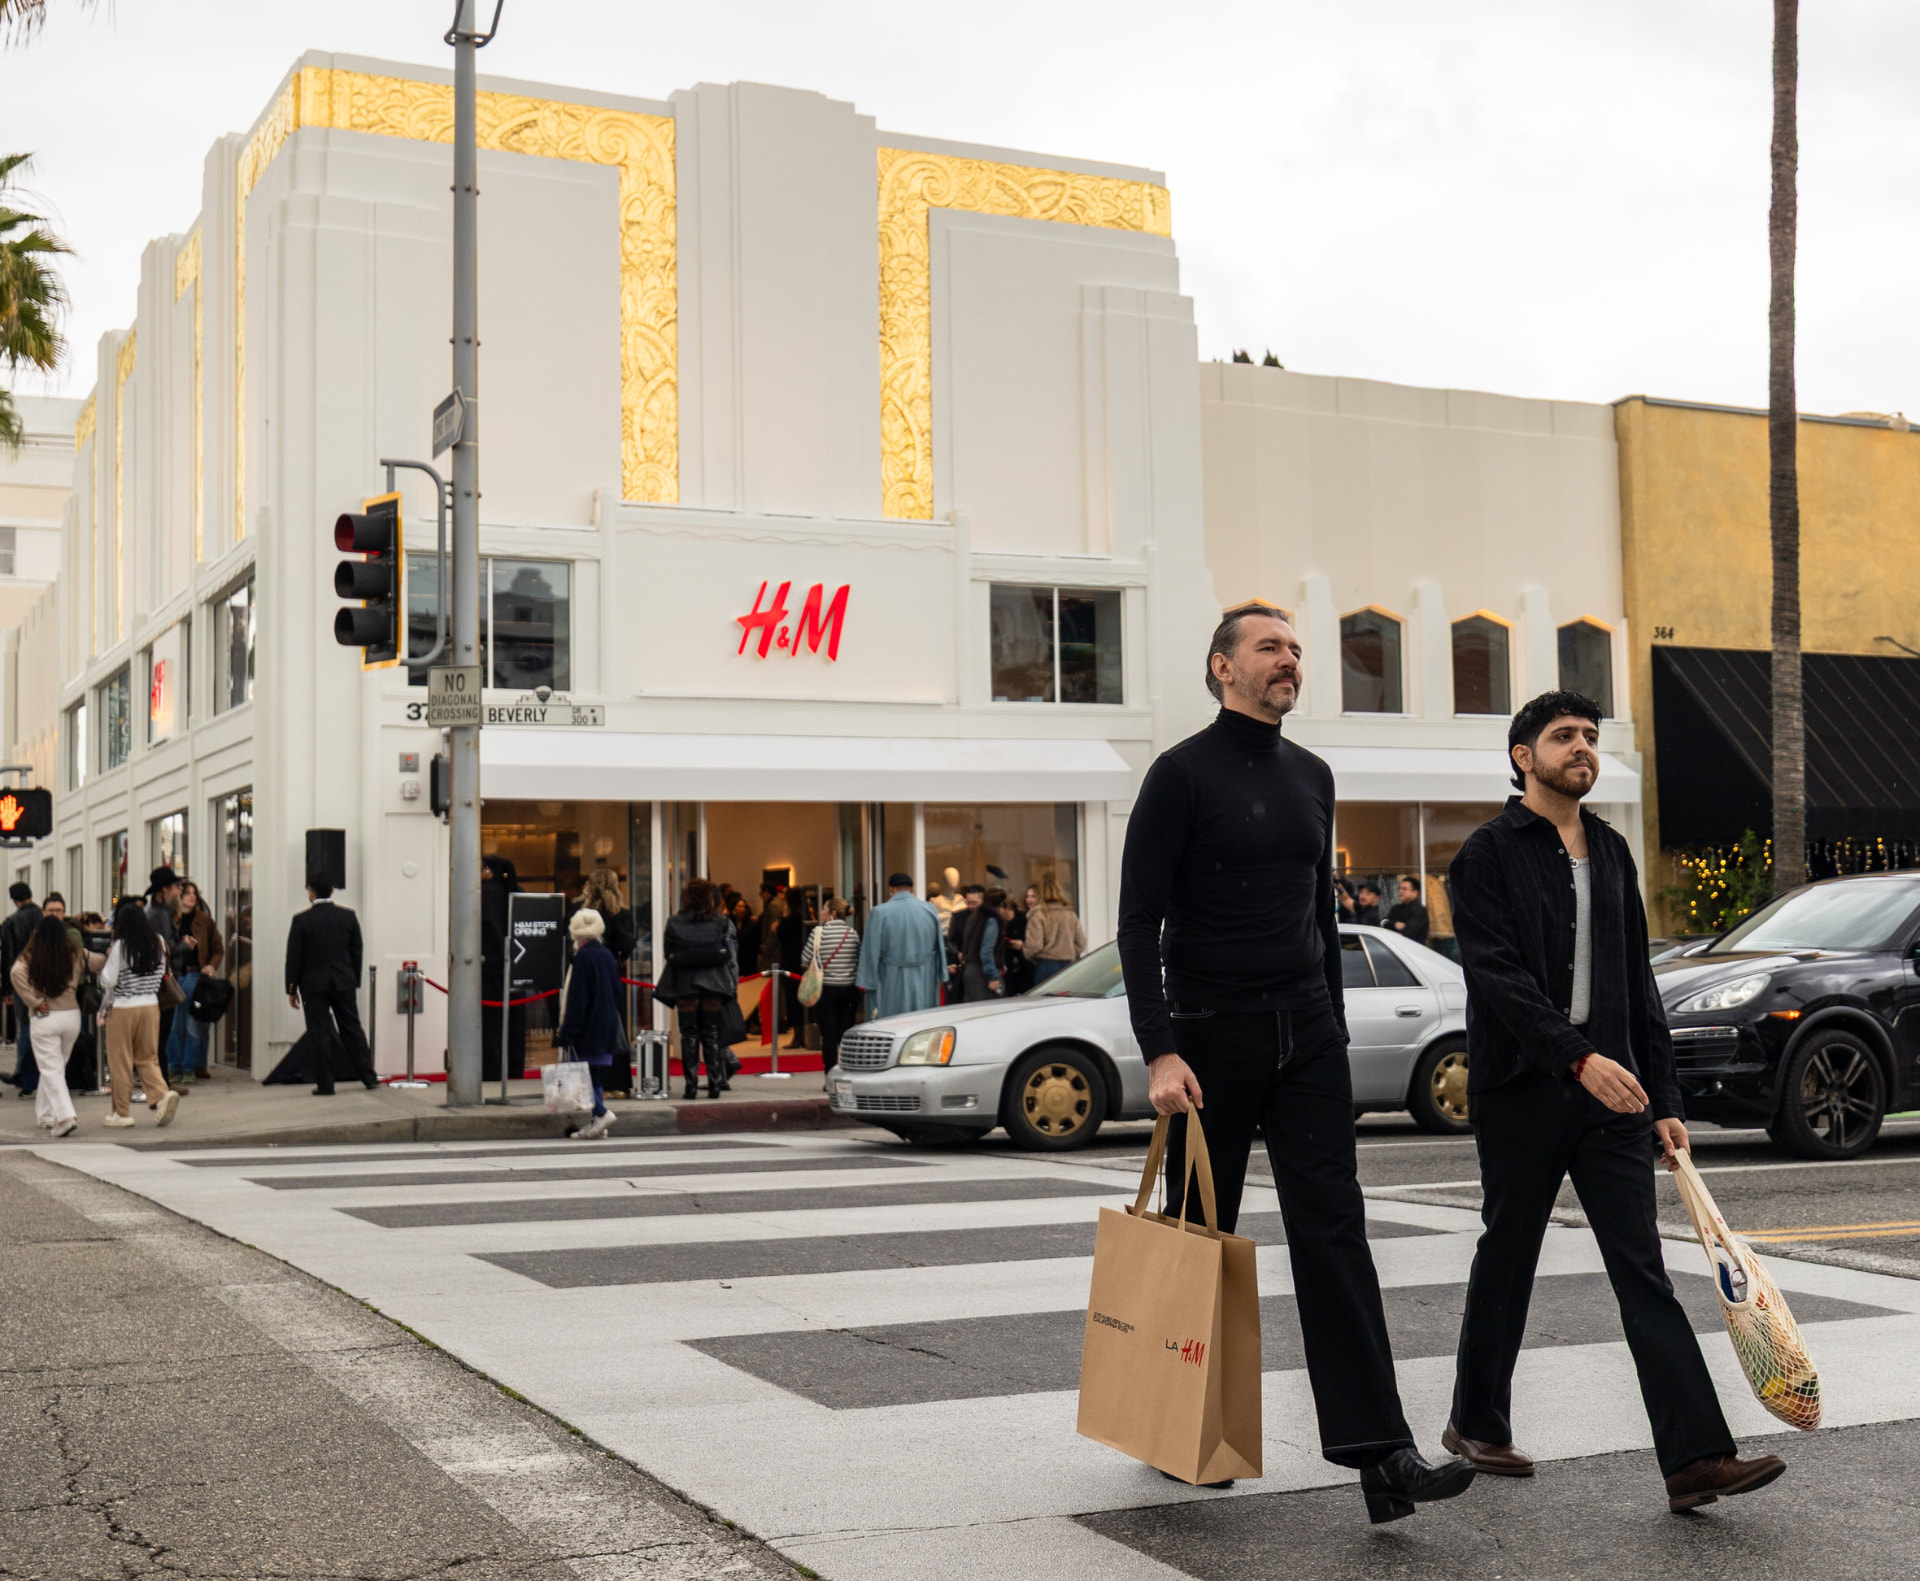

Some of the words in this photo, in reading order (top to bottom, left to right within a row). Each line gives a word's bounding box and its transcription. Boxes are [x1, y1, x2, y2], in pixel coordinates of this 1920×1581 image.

[736, 579, 851, 662] H&M
[1653, 626, 1674, 640] 364
[444, 673, 466, 693] NO
[431, 693, 479, 707] DIAGONAL
[431, 707, 479, 720] CROSSING
[488, 707, 548, 723] BEVERLY
[571, 714, 589, 725] 300
[1165, 1338, 1179, 1353] LA
[1180, 1338, 1206, 1369] H&M
